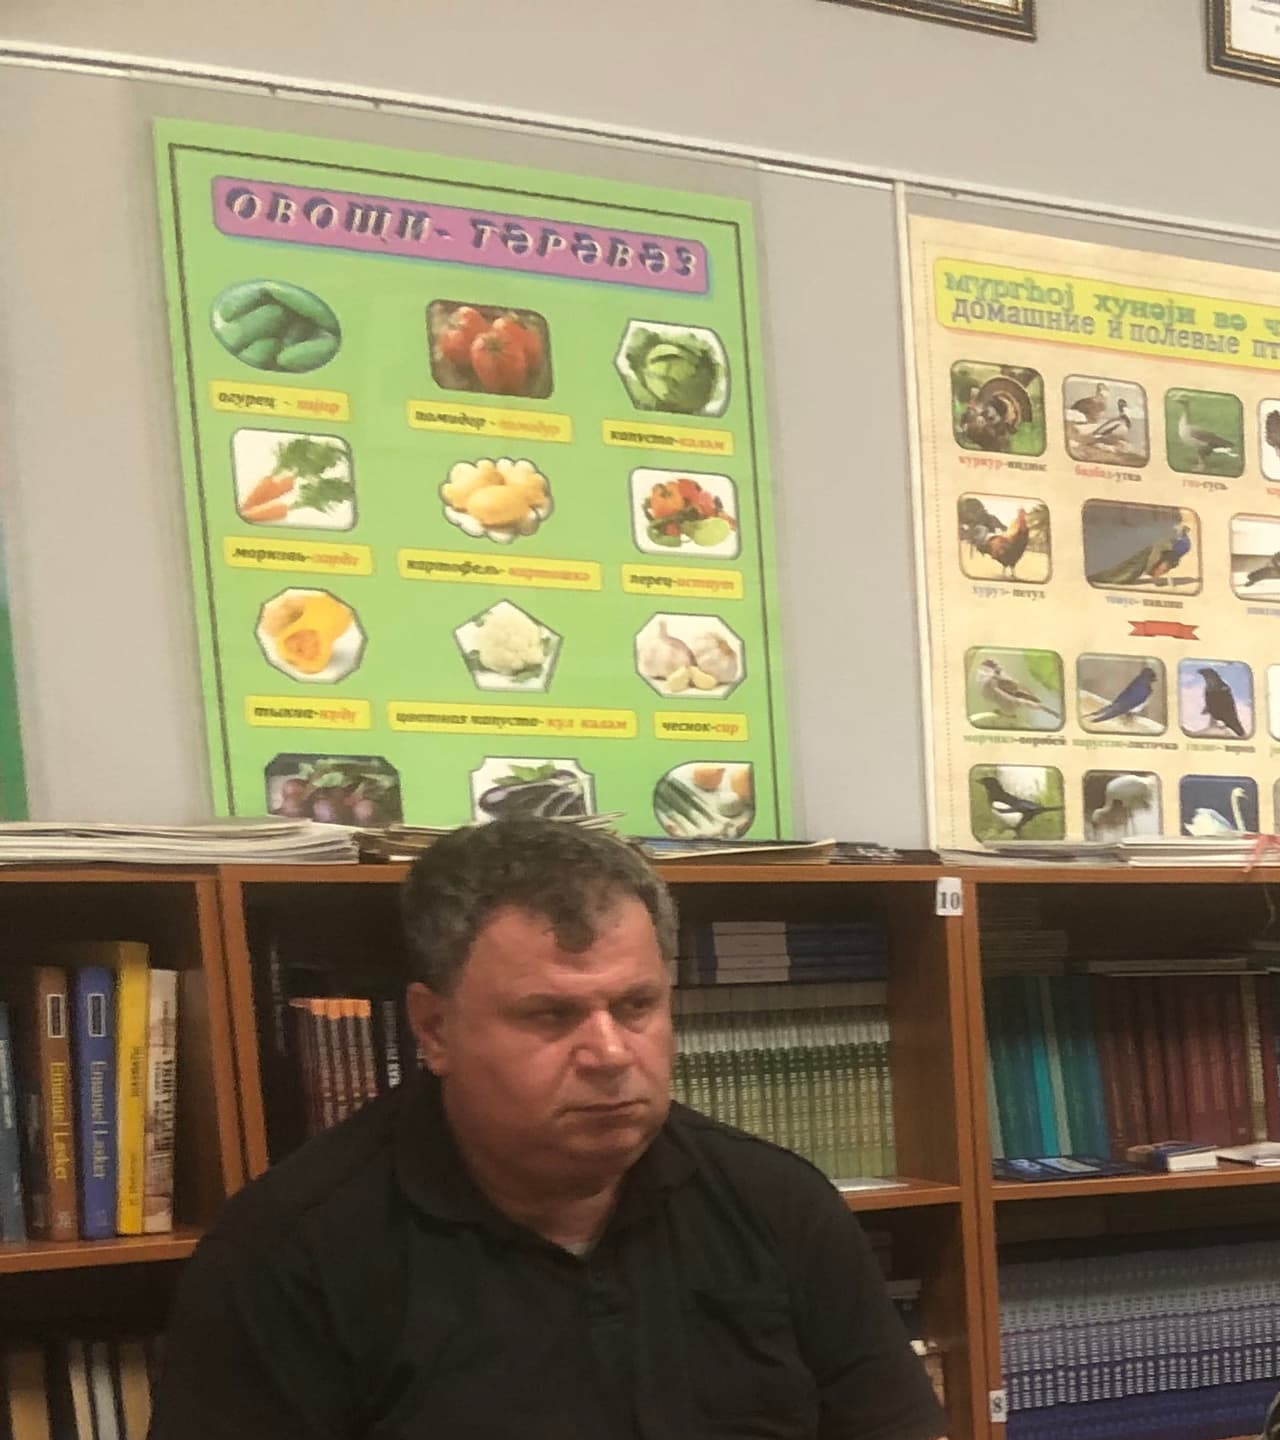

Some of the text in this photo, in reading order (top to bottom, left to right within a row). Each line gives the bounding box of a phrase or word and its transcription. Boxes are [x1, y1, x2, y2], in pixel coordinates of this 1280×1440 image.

[226, 186, 454, 242] ОВОЩИ-
[952, 298, 1095, 336] домашние
[1108, 319, 1123, 339] и
[1130, 322, 1241, 355] полевые
[939, 891, 961, 910] 10
[47, 1062, 72, 1180] Emanuel Lasker
